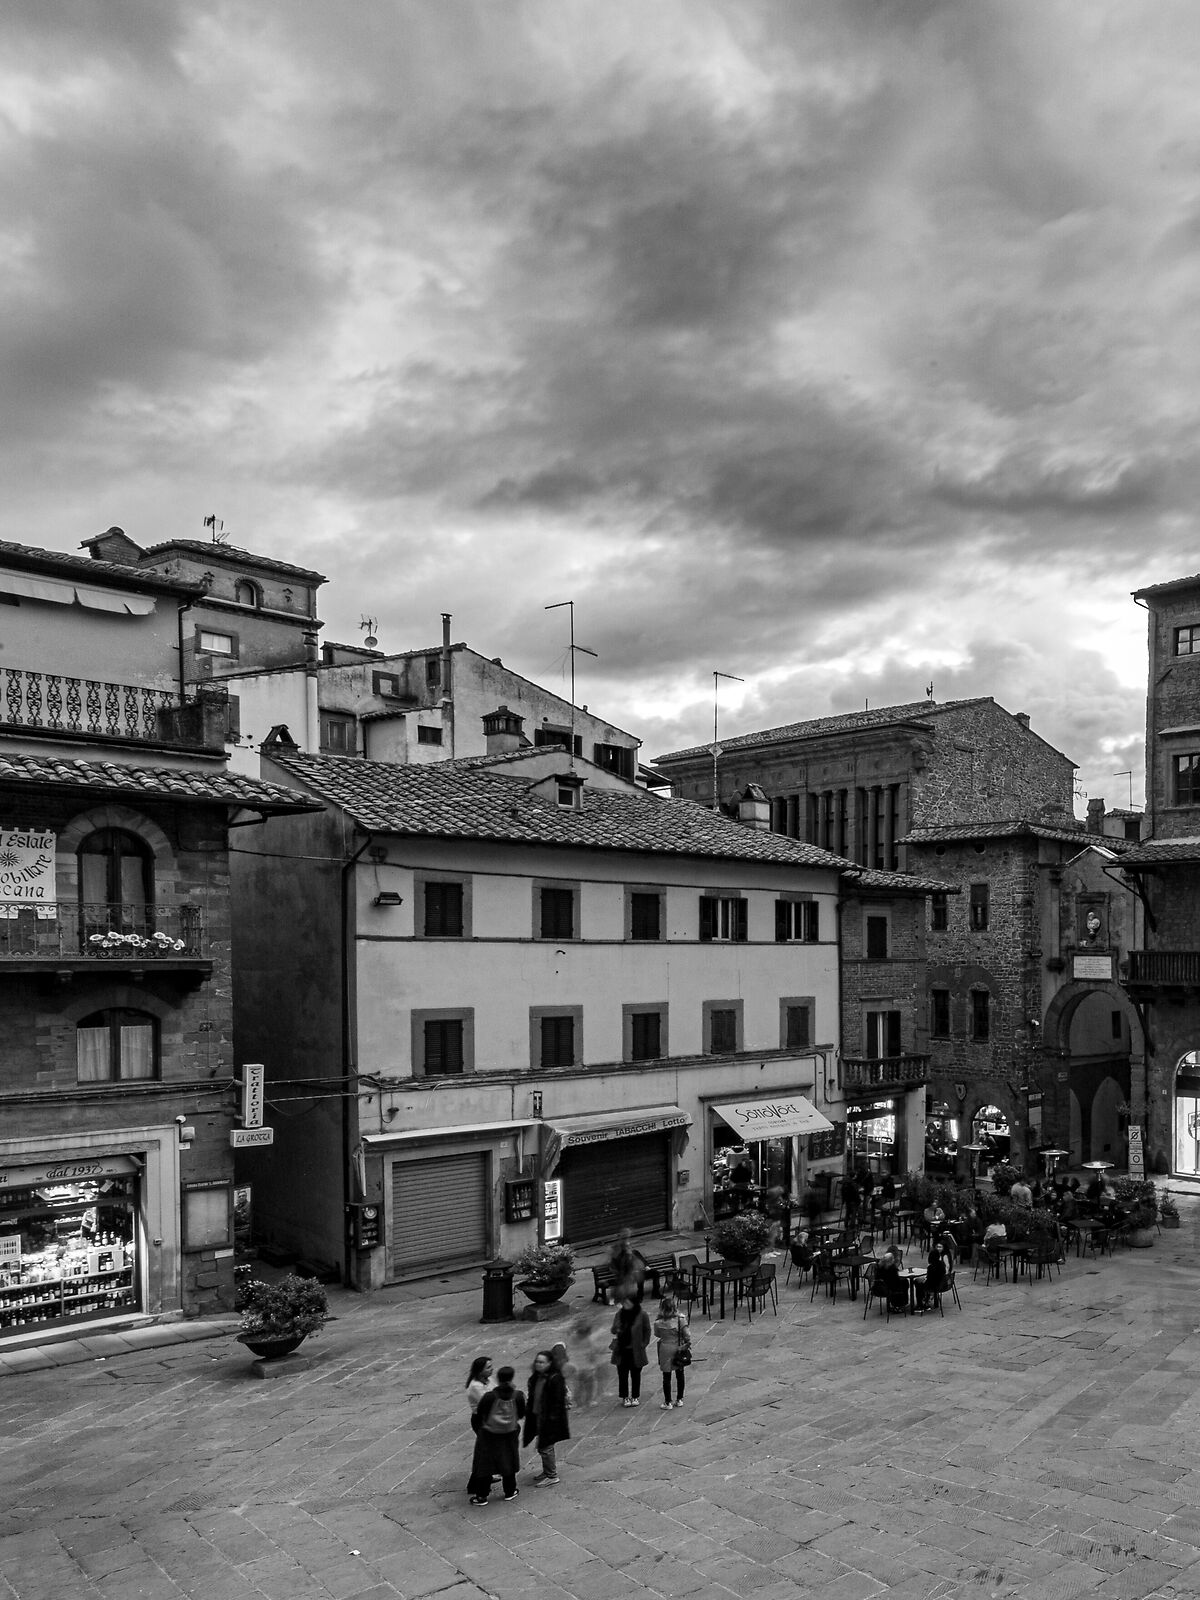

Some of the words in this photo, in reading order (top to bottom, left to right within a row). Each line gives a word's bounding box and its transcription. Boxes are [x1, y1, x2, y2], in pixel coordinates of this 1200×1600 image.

[0, 854, 52, 884] obiliare
[0, 884, 45, 898] cana
[249, 1067, 261, 1125] Trattoria
[568, 1132, 608, 1144] Souvenir
[614, 1122, 656, 1136] TABACCHI
[662, 1117, 686, 1127] Lotto
[46, 1166, 71, 1179] dal
[72, 1165, 98, 1175] 1937
